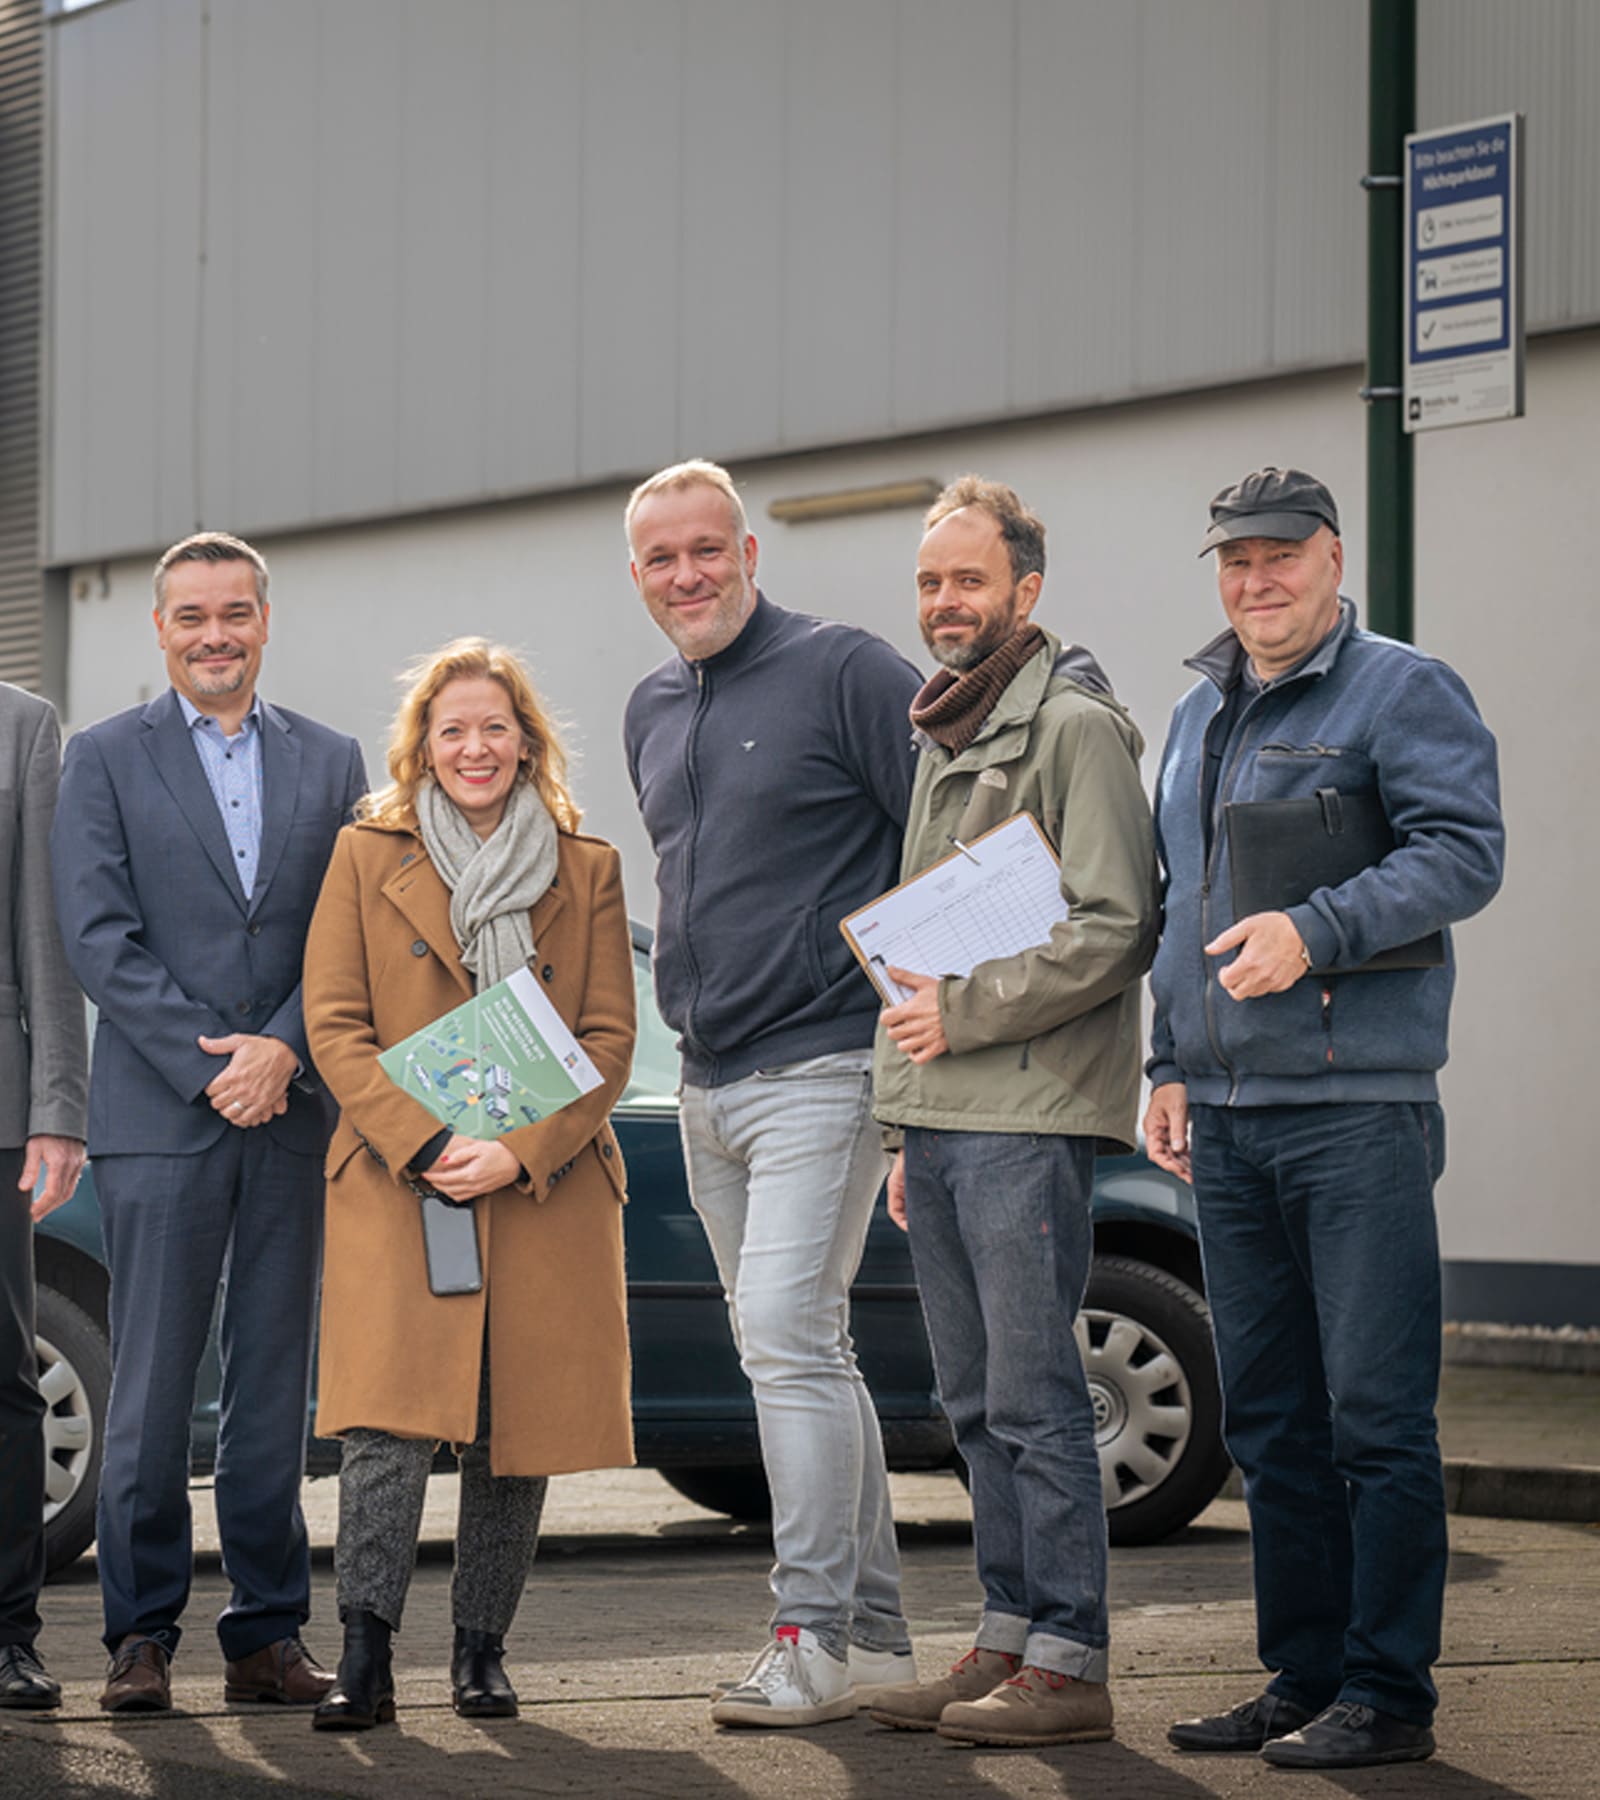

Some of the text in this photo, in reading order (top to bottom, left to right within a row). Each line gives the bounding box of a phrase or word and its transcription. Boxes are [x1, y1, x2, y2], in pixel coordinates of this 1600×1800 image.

[1414, 137, 1505, 170] Bitte beachten Sie die
